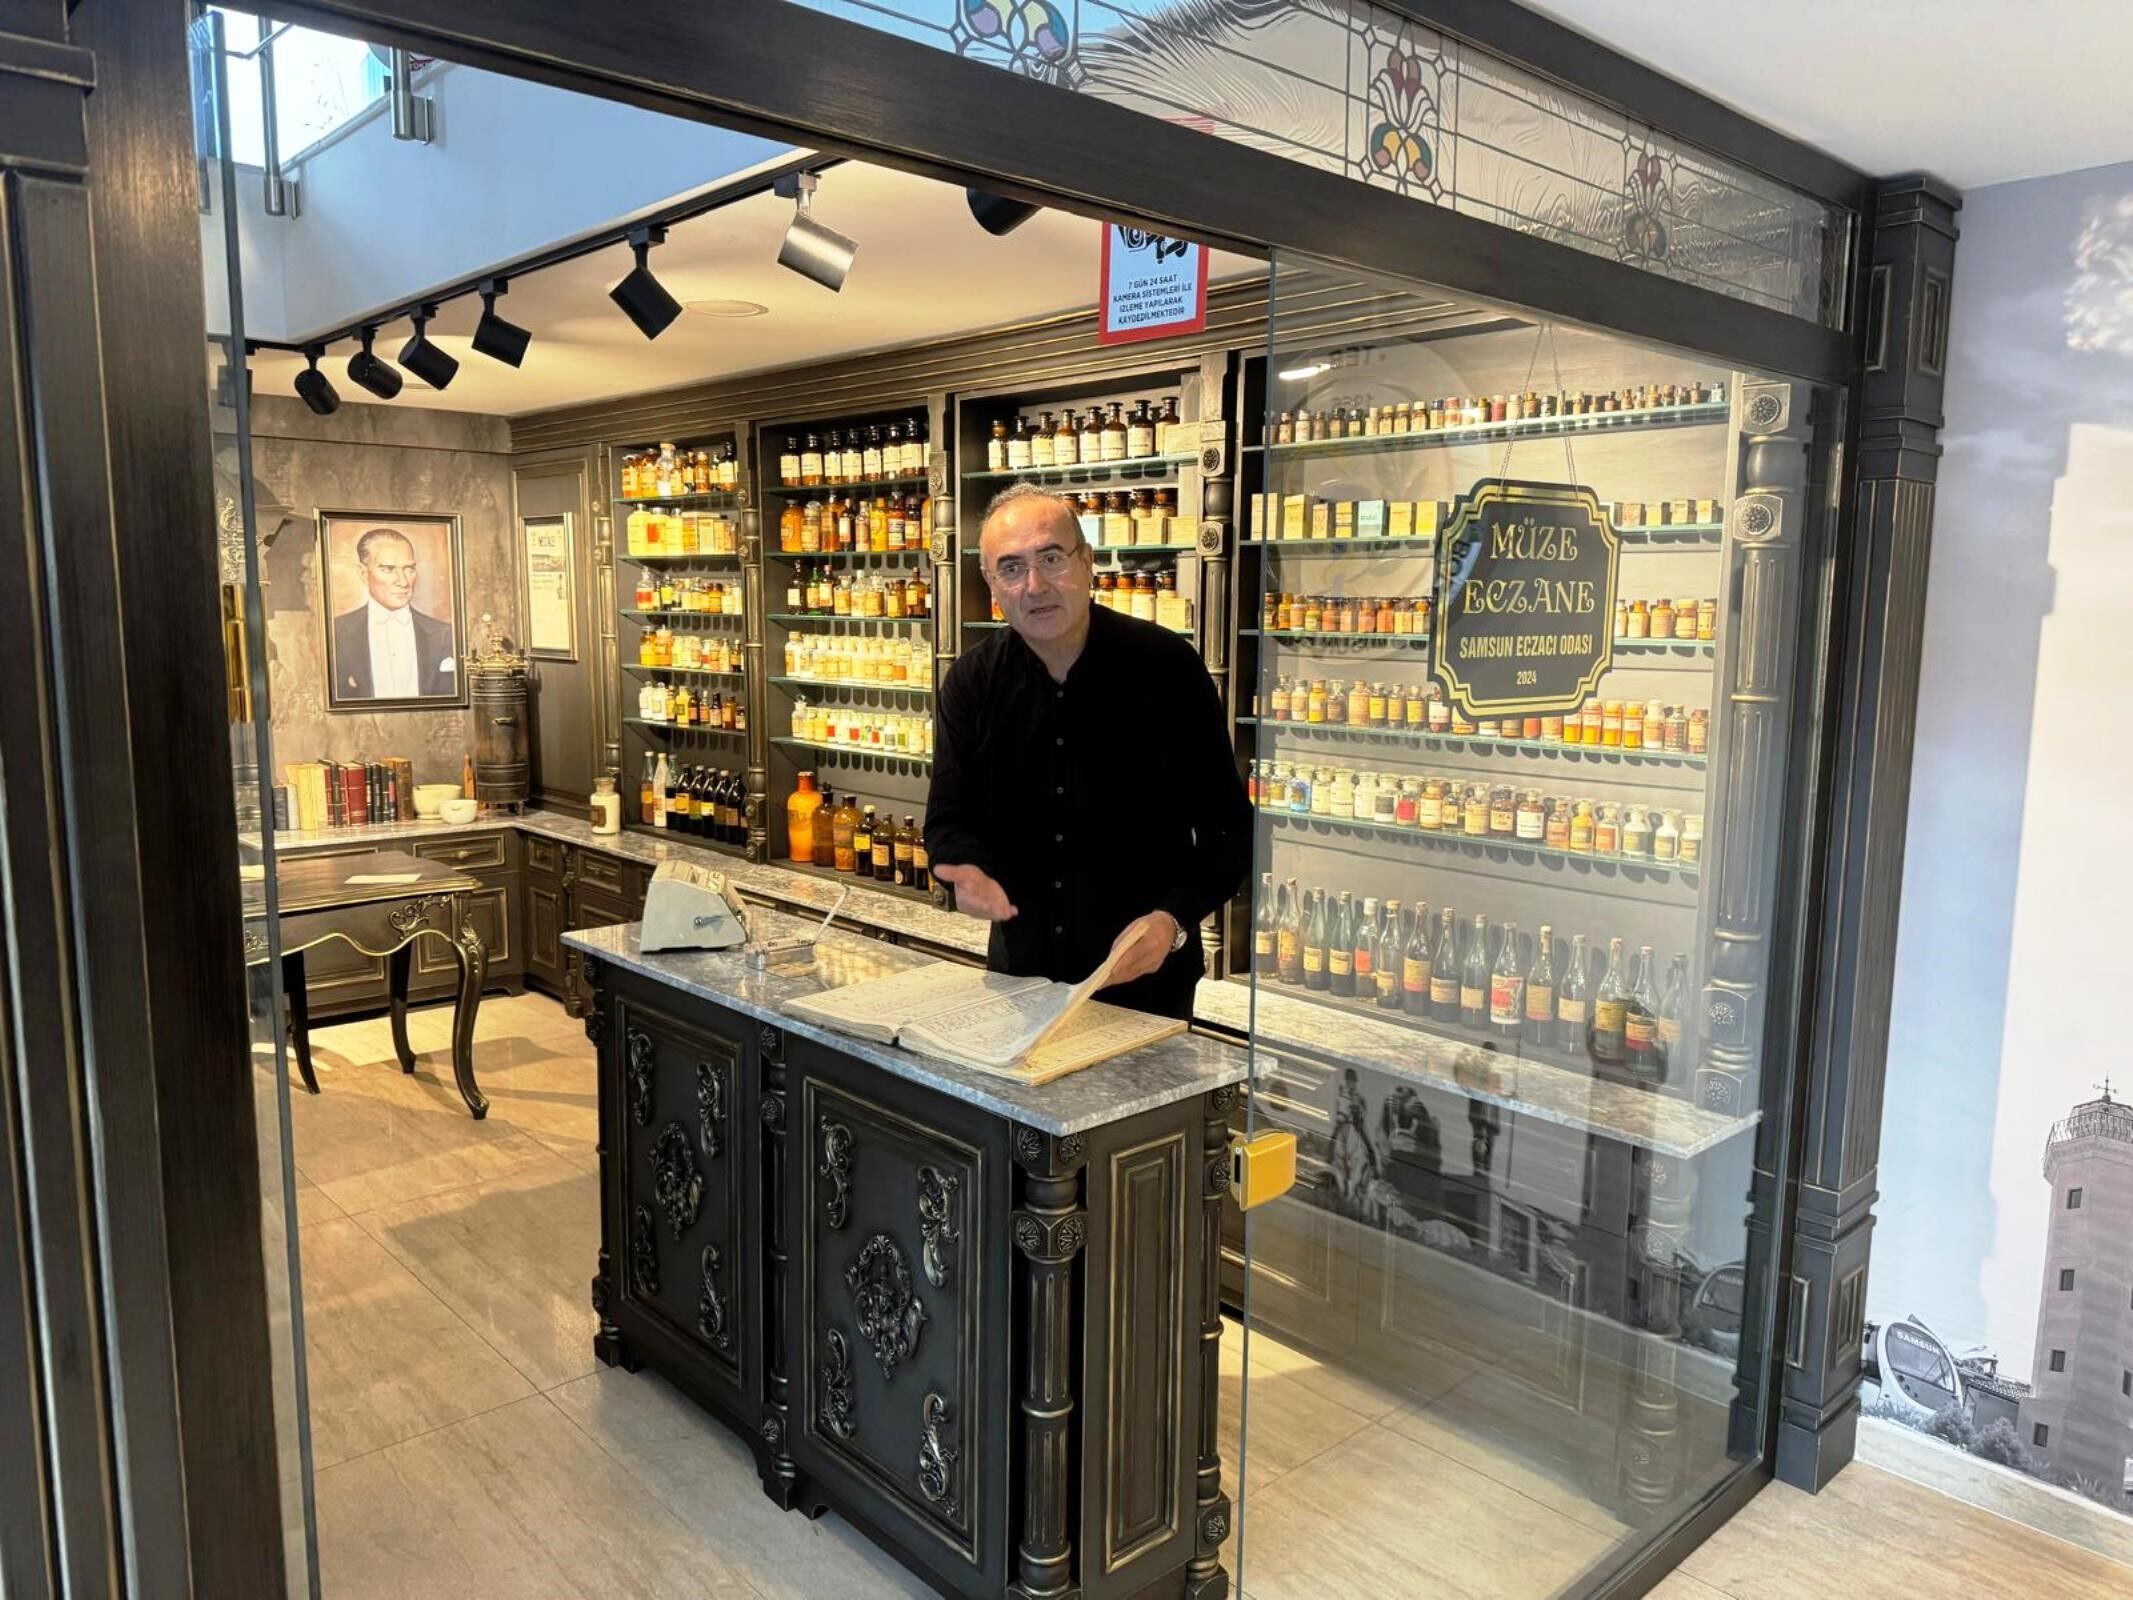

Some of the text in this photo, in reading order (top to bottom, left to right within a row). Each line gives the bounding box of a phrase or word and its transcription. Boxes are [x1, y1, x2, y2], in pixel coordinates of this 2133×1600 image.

[1134, 278, 1148, 288] GÜN
[1150, 278, 1158, 286] 24
[1159, 274, 1177, 284] SAAT
[1113, 293, 1140, 302] KAMERA
[1144, 296, 1182, 308] YAPILARAK
[1490, 517, 1578, 560] MÜZE
[1462, 578, 1595, 614] ECZANE
[1459, 634, 1592, 658] SAMSUN ECZACI ODASI
[1517, 671, 1537, 684] 2024
[1896, 1331, 1939, 1354] SAMSUN
